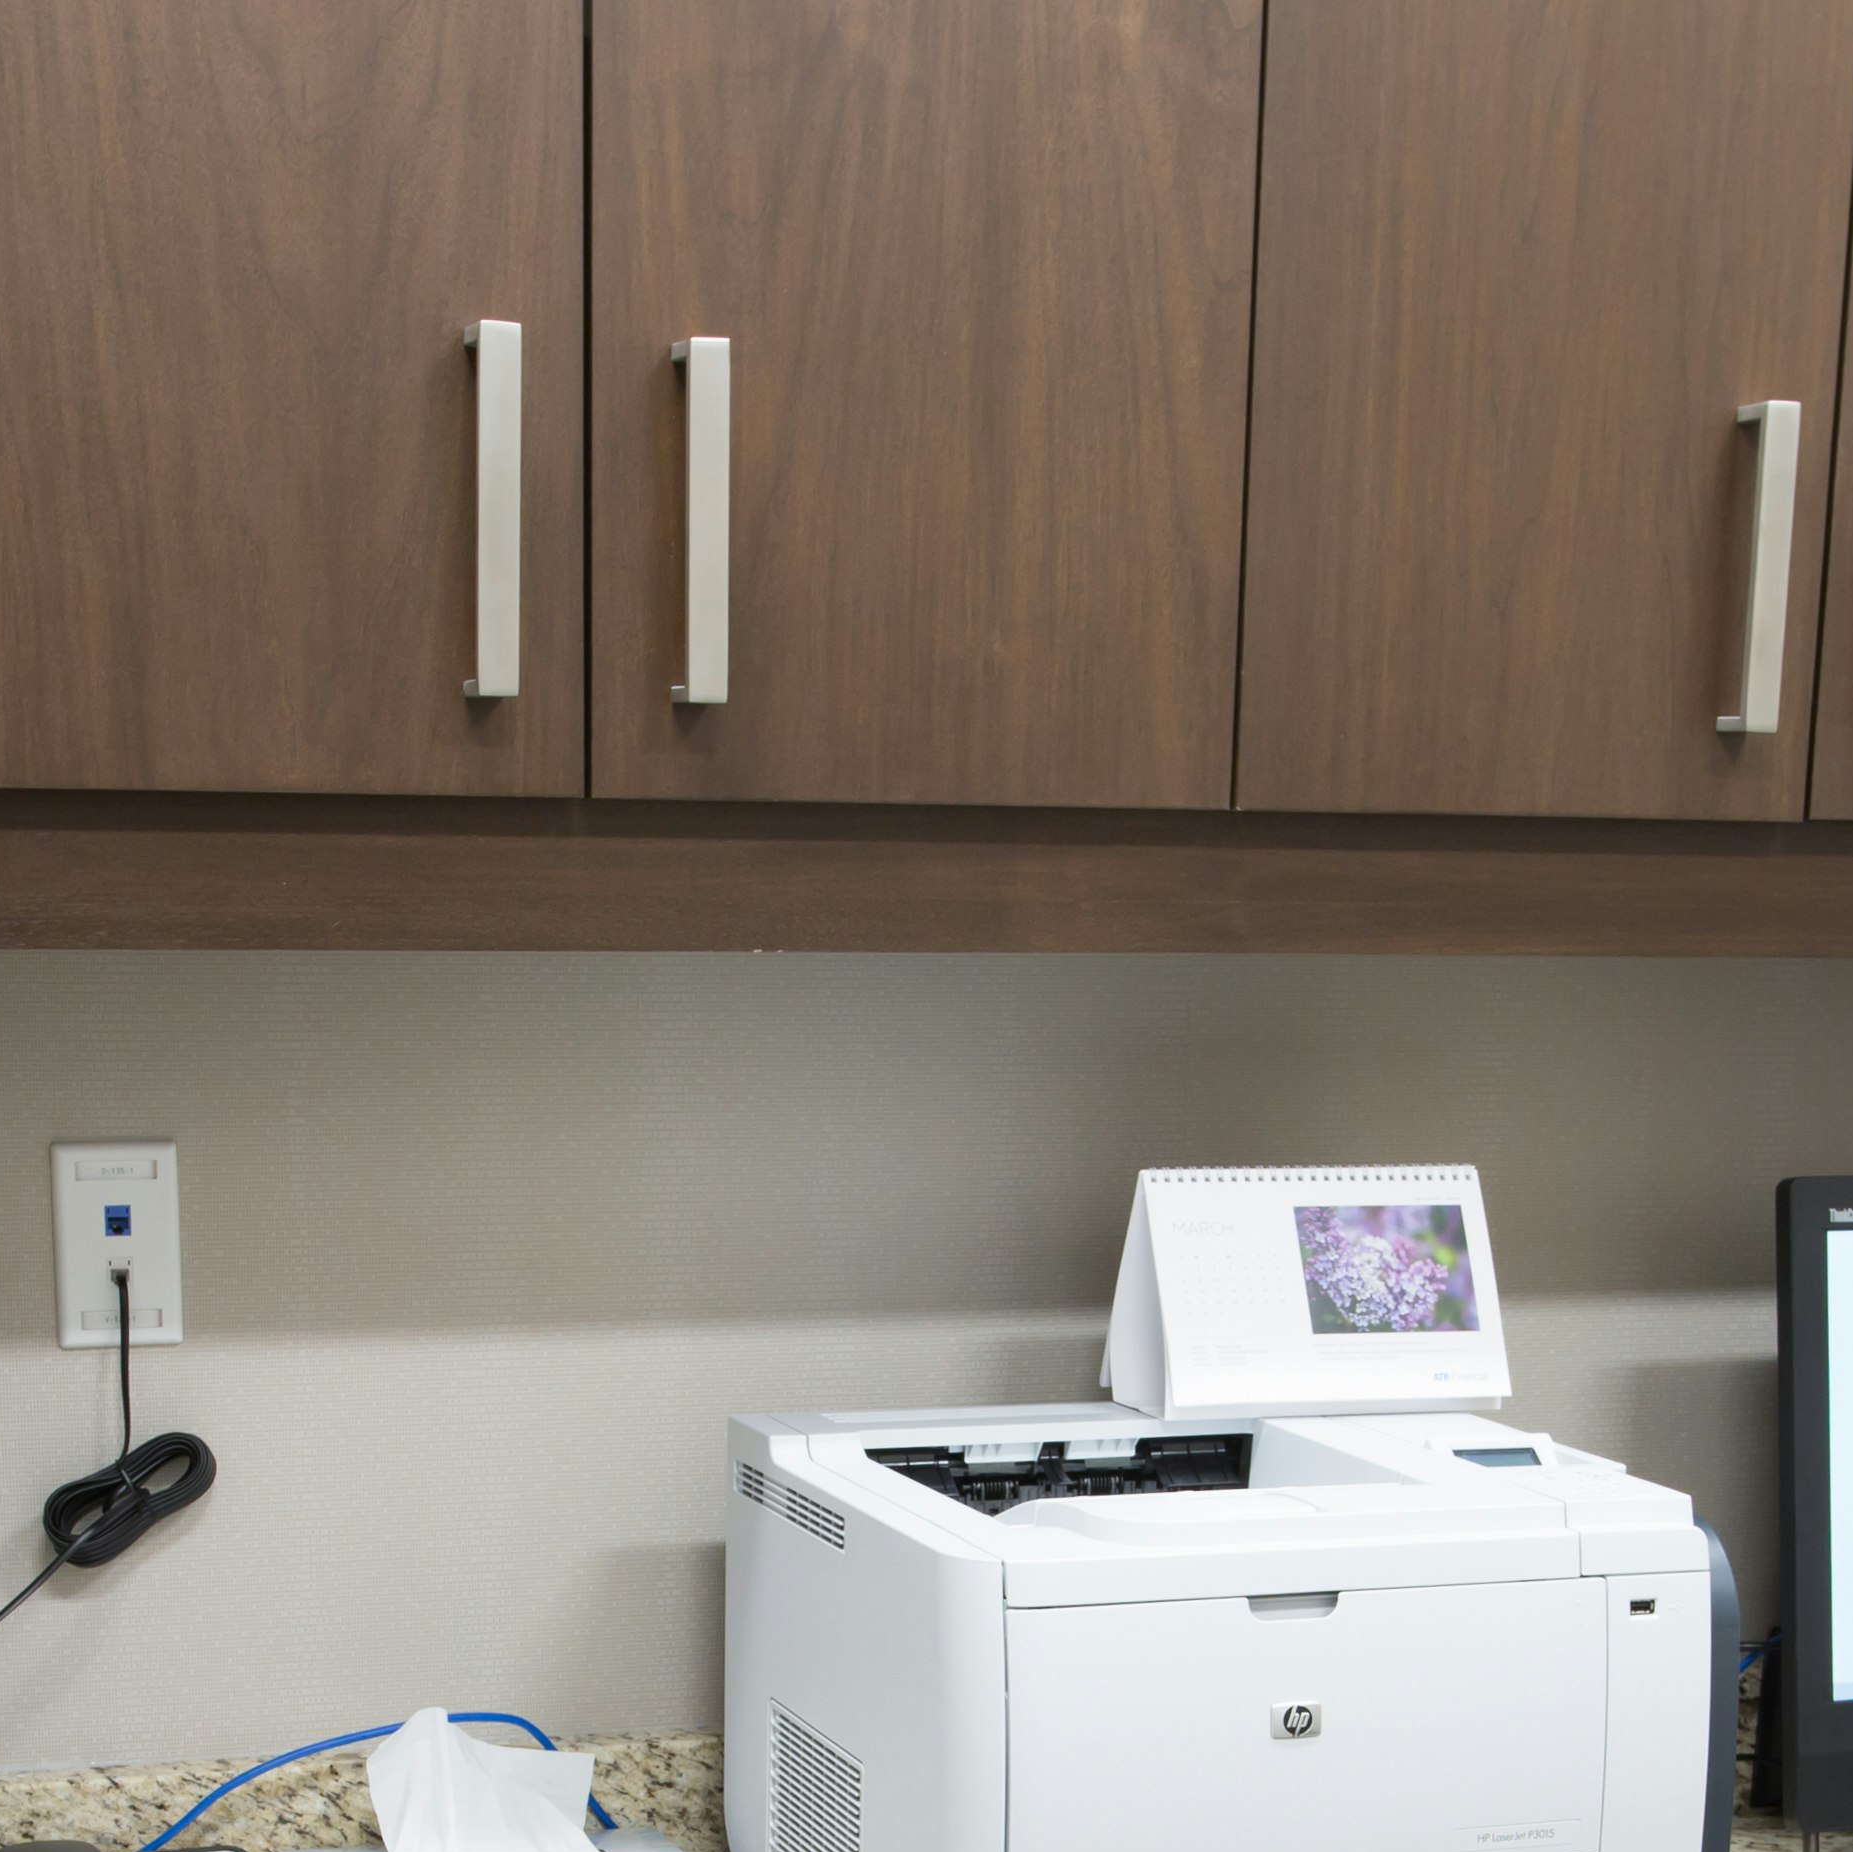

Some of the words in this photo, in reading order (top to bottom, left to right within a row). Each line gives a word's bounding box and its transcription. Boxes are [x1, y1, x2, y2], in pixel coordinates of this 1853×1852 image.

[1171, 1219, 1235, 1238] MARCH
[1285, 1705, 1312, 1738] hp
[1477, 1832, 1491, 1843] HP
[1492, 1831, 1526, 1843] LaserJet
[1527, 1828, 1555, 1841] P3015
